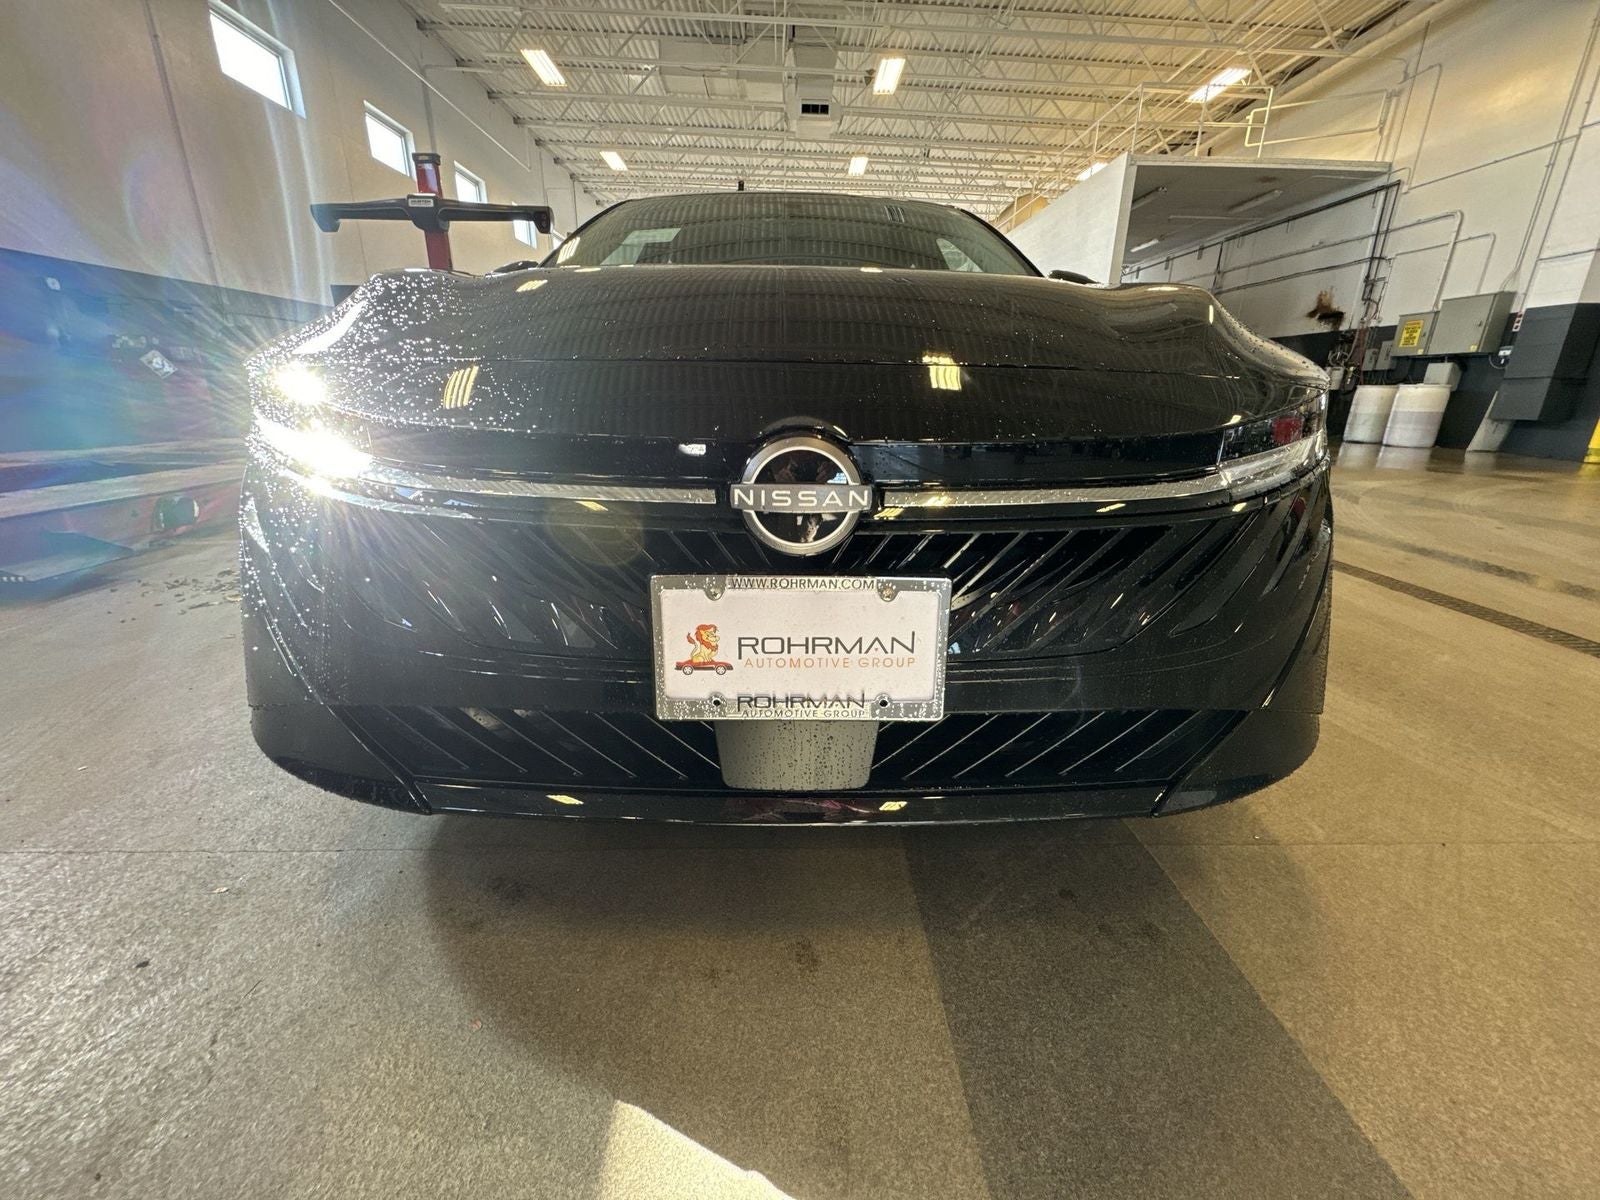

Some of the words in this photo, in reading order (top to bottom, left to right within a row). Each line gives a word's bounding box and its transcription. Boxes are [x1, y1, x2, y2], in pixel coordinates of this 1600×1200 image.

[733, 488, 868, 507] NISSAN
[732, 577, 875, 590] WWW.ROHRMAN.COM
[738, 631, 915, 660] ROHRMAN
[744, 657, 850, 669] AUTOMOTIVE
[855, 657, 916, 668] GROUP
[737, 693, 865, 712] ROHRMAN
[741, 709, 819, 718] AUTOMOTIVE
[823, 709, 866, 718] GROUP
